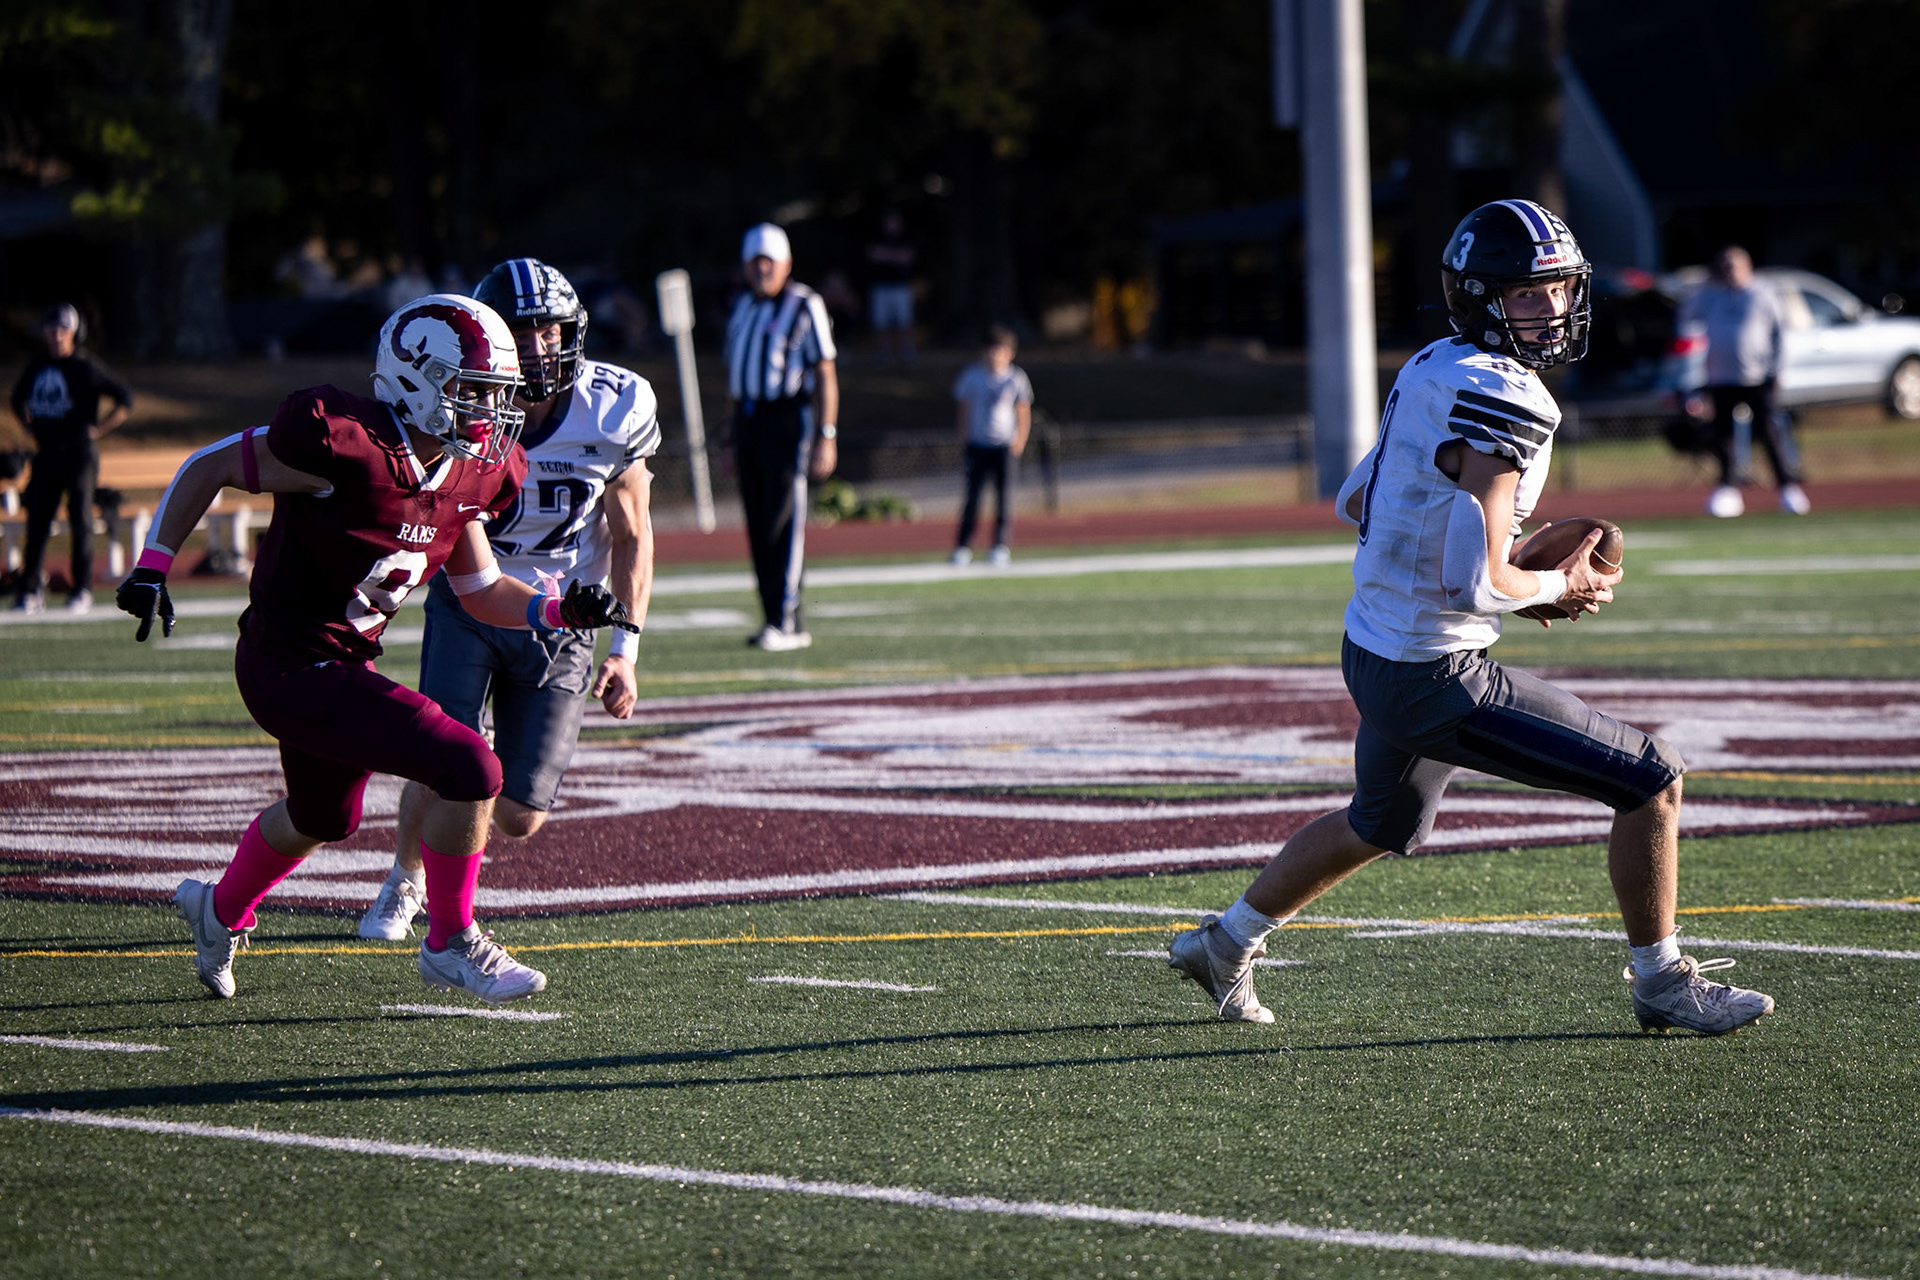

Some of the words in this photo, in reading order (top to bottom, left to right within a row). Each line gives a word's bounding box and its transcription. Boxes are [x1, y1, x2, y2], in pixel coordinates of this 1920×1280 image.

[1452, 231, 1475, 271] 3
[1537, 255, 1567, 266] Riddell
[516, 306, 547, 316] Riddell
[591, 365, 625, 397] 22
[396, 522, 438, 544] RAMS
